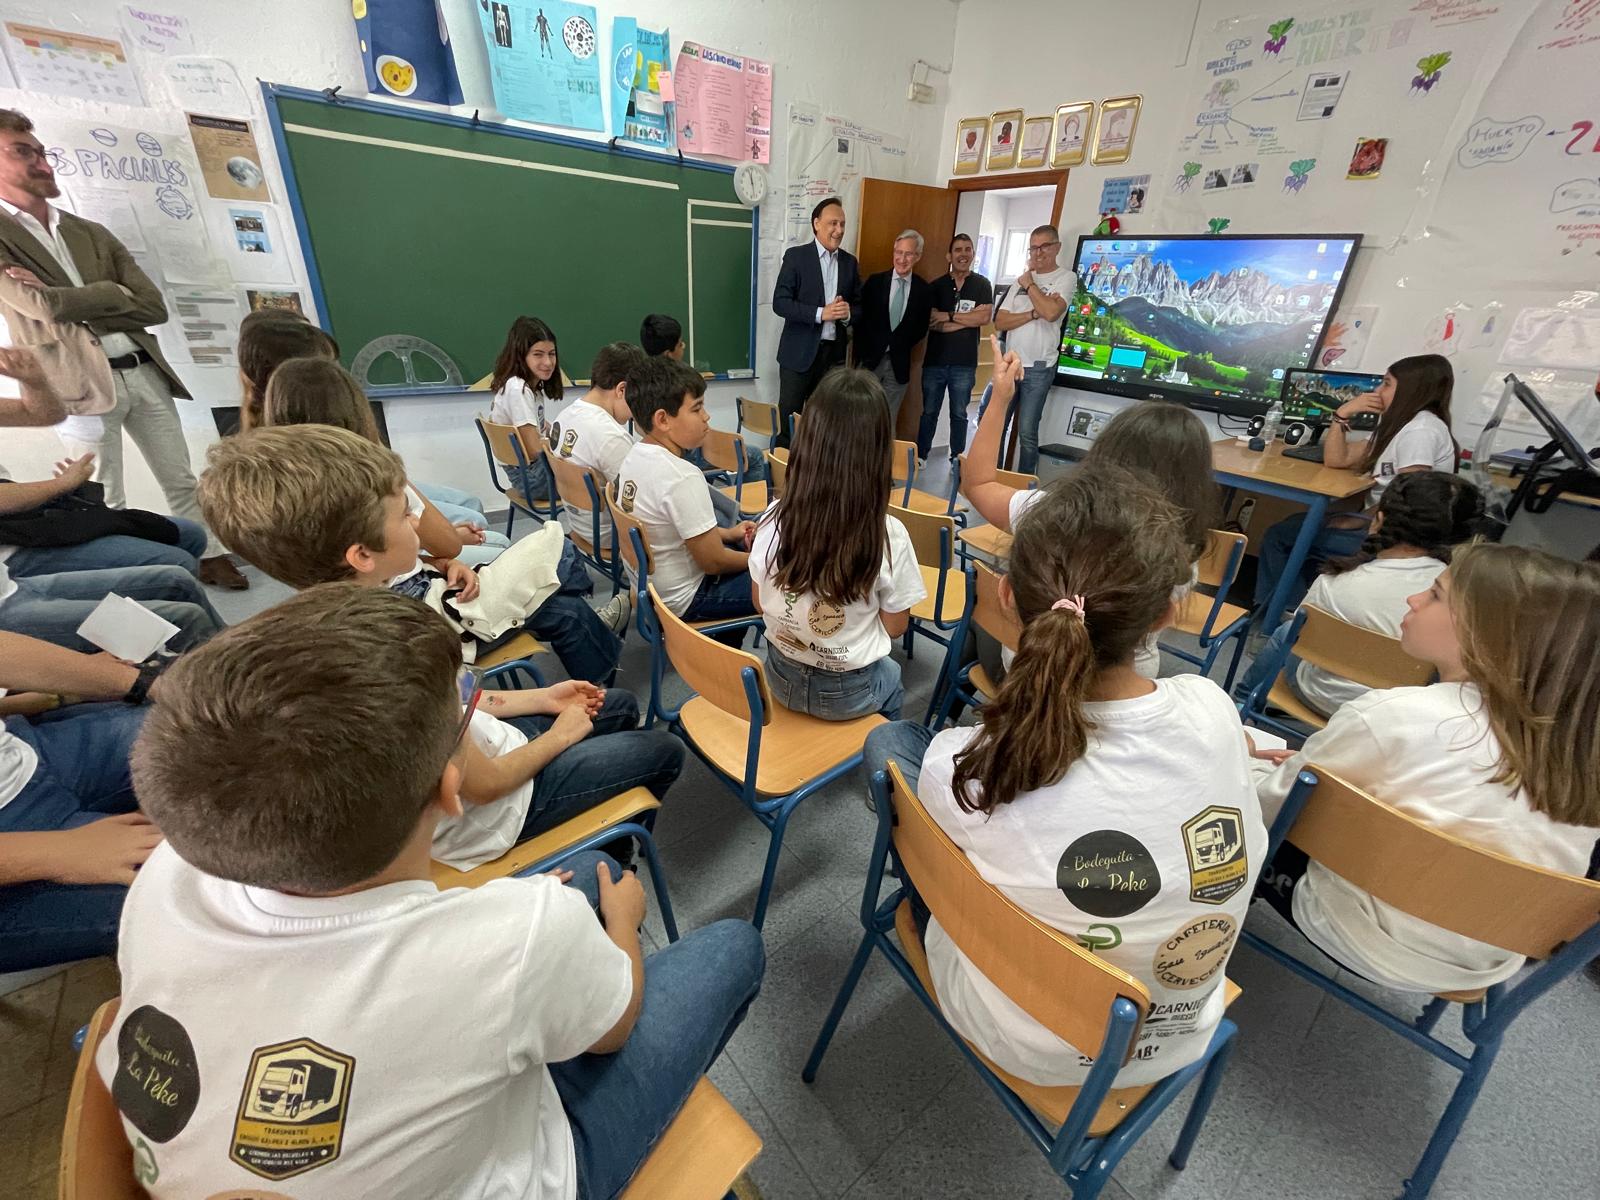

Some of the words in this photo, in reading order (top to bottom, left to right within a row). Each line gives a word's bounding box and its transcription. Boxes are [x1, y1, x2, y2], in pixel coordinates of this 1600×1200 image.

[1472, 123, 1536, 142] HUERTO
[48, 147, 189, 187] SPACIALES
[1074, 850, 1134, 871] Bodeguita
[1108, 871, 1148, 892] Peke
[1166, 919, 1231, 951] CAFETERIA
[1157, 957, 1185, 974] San
[127, 1051, 143, 1081] La
[143, 1066, 179, 1107] Peke
[264, 1127, 309, 1136] TRANSPORTES
